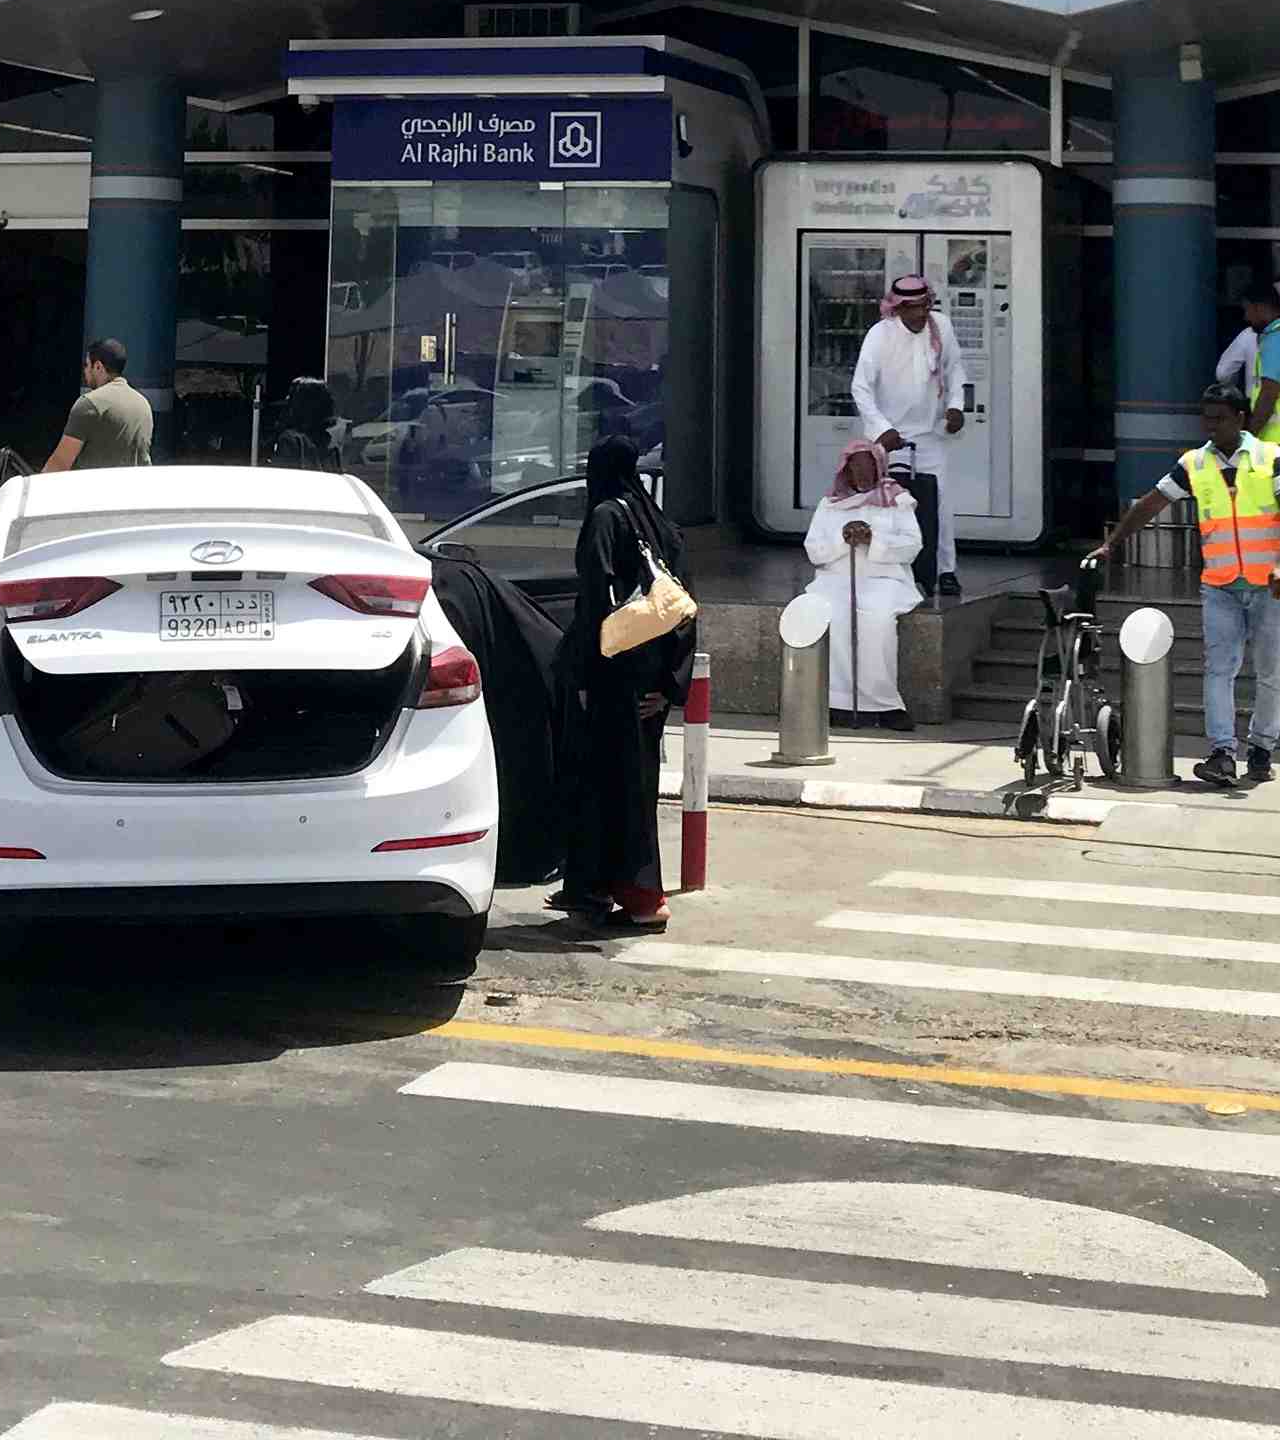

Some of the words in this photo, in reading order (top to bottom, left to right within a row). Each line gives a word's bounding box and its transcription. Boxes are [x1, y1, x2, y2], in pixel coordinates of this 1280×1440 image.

[401, 111, 473, 140] الراجحي
[478, 113, 536, 138] مصرف
[400, 142, 422, 163] Al
[428, 142, 478, 168] Rajhi
[483, 142, 536, 163] Bank
[167, 618, 217, 638] 9320
